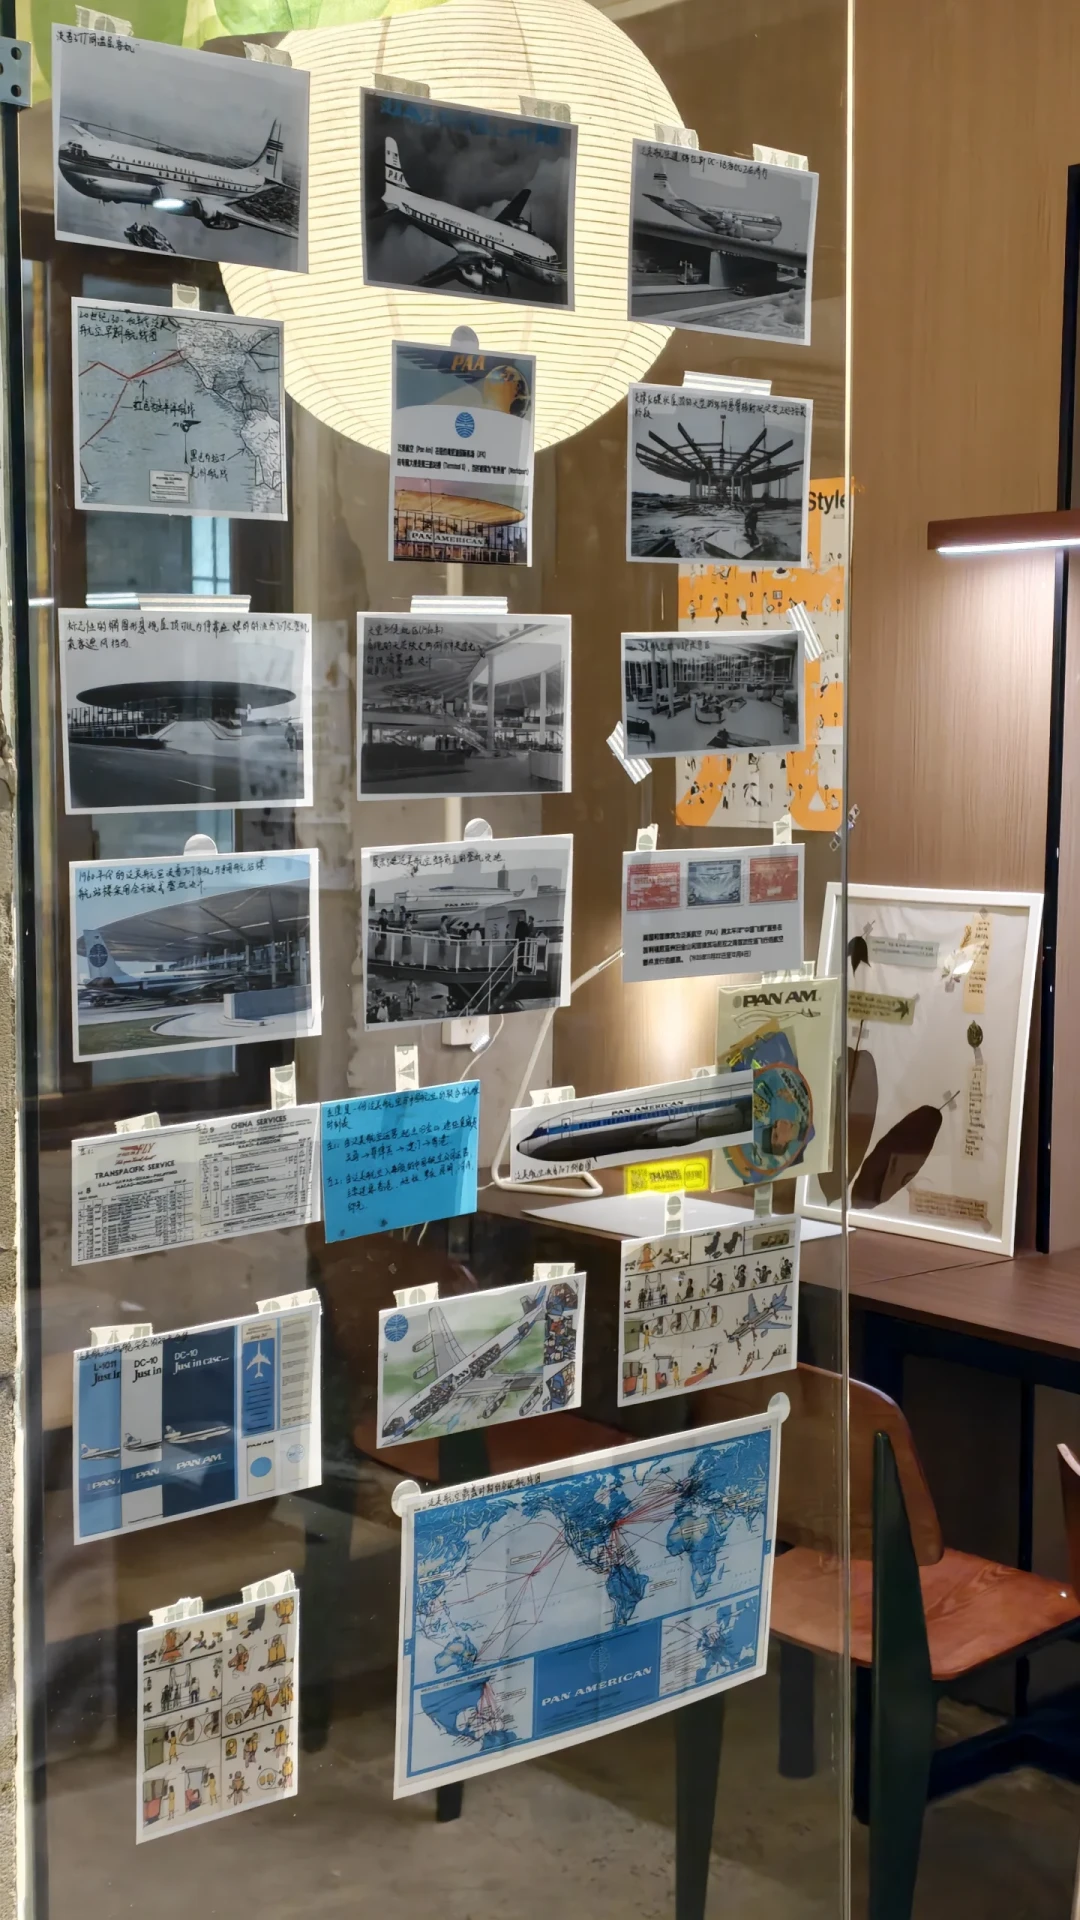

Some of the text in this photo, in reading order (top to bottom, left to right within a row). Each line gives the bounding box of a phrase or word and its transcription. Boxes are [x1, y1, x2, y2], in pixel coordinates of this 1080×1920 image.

[450, 354, 487, 371] PAA
[411, 532, 483, 545] PAN AMERICAN
[743, 992, 783, 1008] PAN
[611, 1100, 685, 1116] PAN AMERICAN
[231, 1115, 287, 1130] CHINA SERVICES
[94, 1160, 175, 1180] TRANSPACIFIC SERVICE
[134, 1356, 158, 1368] DC-10
[174, 1349, 198, 1361] DC-10
[93, 1359, 117, 1371] L-1011
[172, 1361, 191, 1375] Just
[192, 1358, 202, 1368] in
[91, 1372, 113, 1387] Just
[132, 1367, 162, 1383] Just in
[176, 1453, 223, 1470] PAN AM
[136, 1468, 160, 1479] PAN
[92, 1478, 116, 1490] PAN
[541, 1666, 653, 1707] PAN AMERICAN
